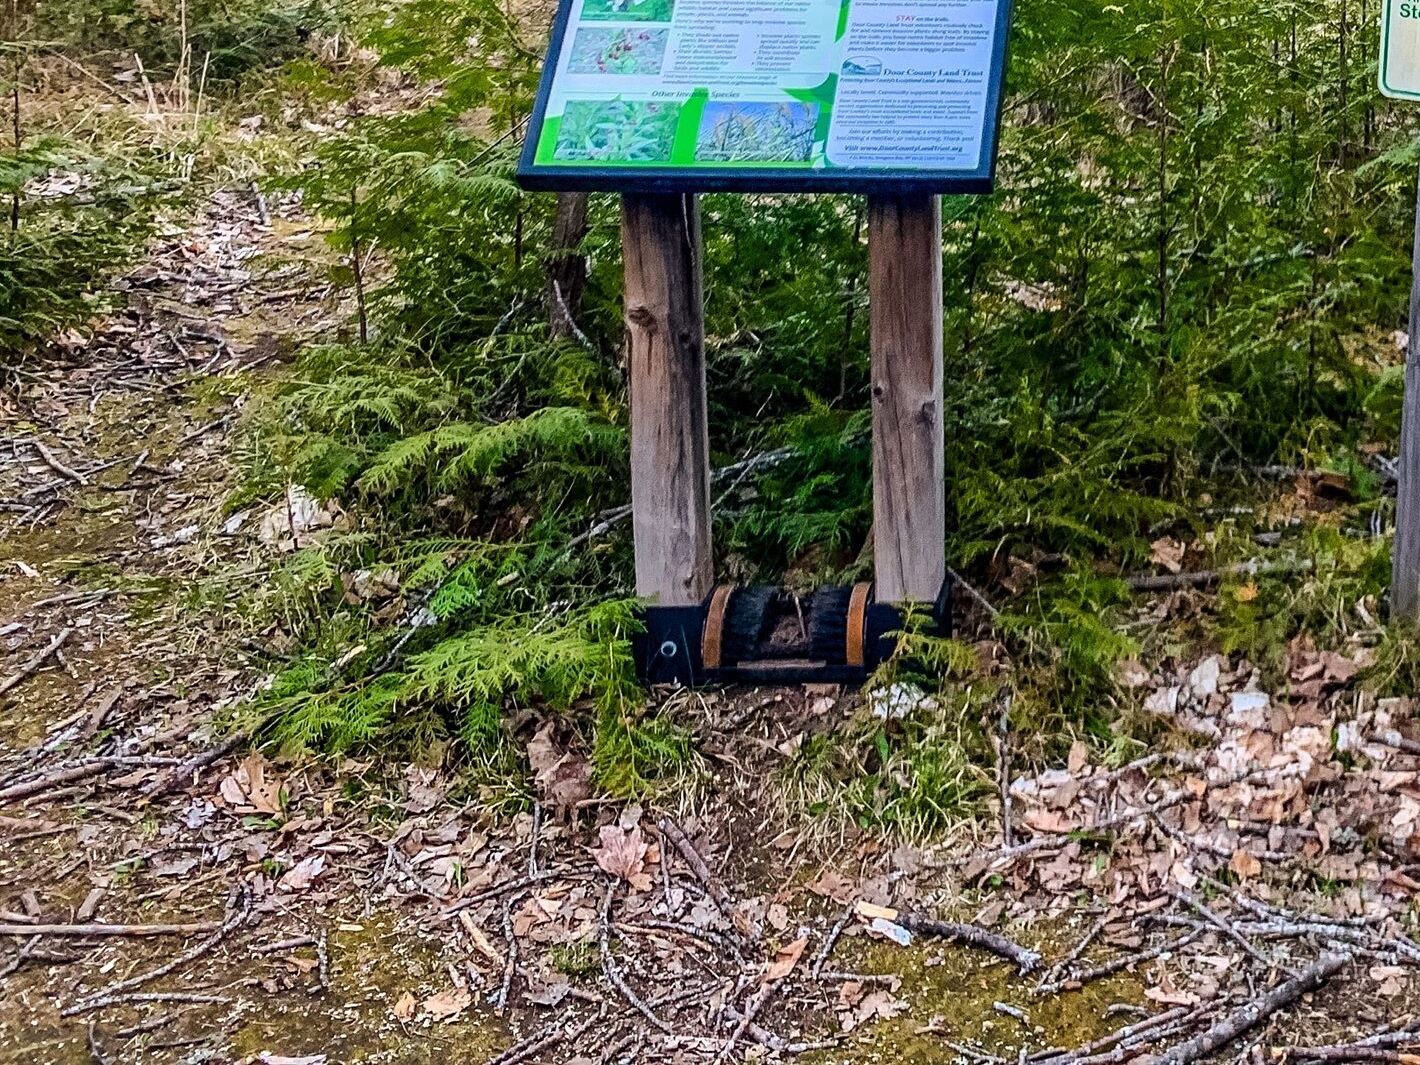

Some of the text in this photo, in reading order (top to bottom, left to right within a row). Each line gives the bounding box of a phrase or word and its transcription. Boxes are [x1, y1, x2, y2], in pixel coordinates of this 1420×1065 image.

[884, 68, 984, 77] Door County Land Trust
[652, 90, 675, 98] Other
[711, 90, 740, 99] Species
